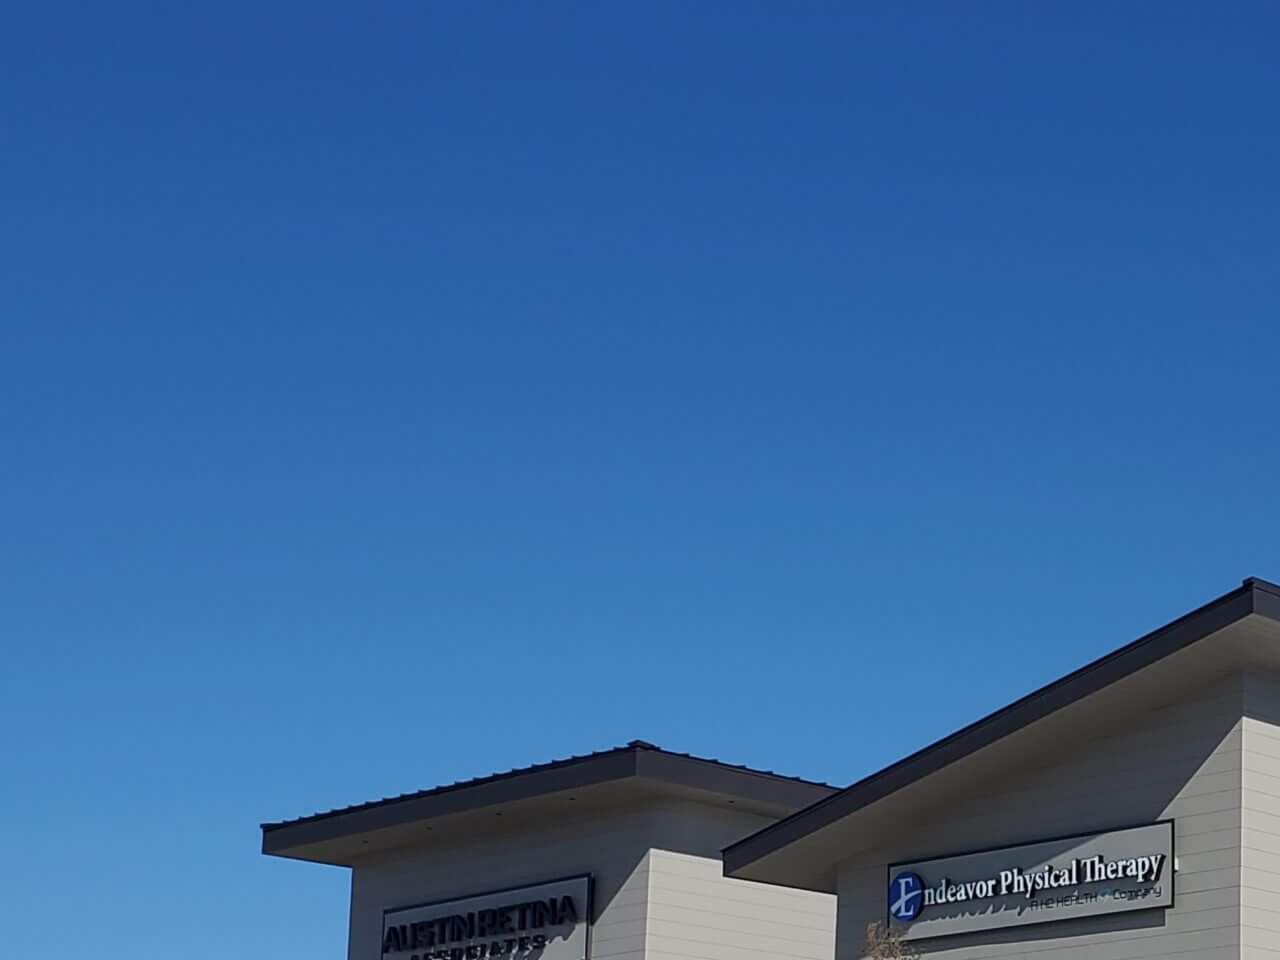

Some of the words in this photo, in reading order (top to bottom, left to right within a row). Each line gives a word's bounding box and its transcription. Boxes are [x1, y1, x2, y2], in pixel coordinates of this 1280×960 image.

[891, 877, 997, 917] Endeavor
[1000, 859, 1078, 899] Physical
[1081, 854, 1162, 883] Therapy
[383, 912, 475, 953] AUSTIN
[478, 895, 577, 938] RETINA
